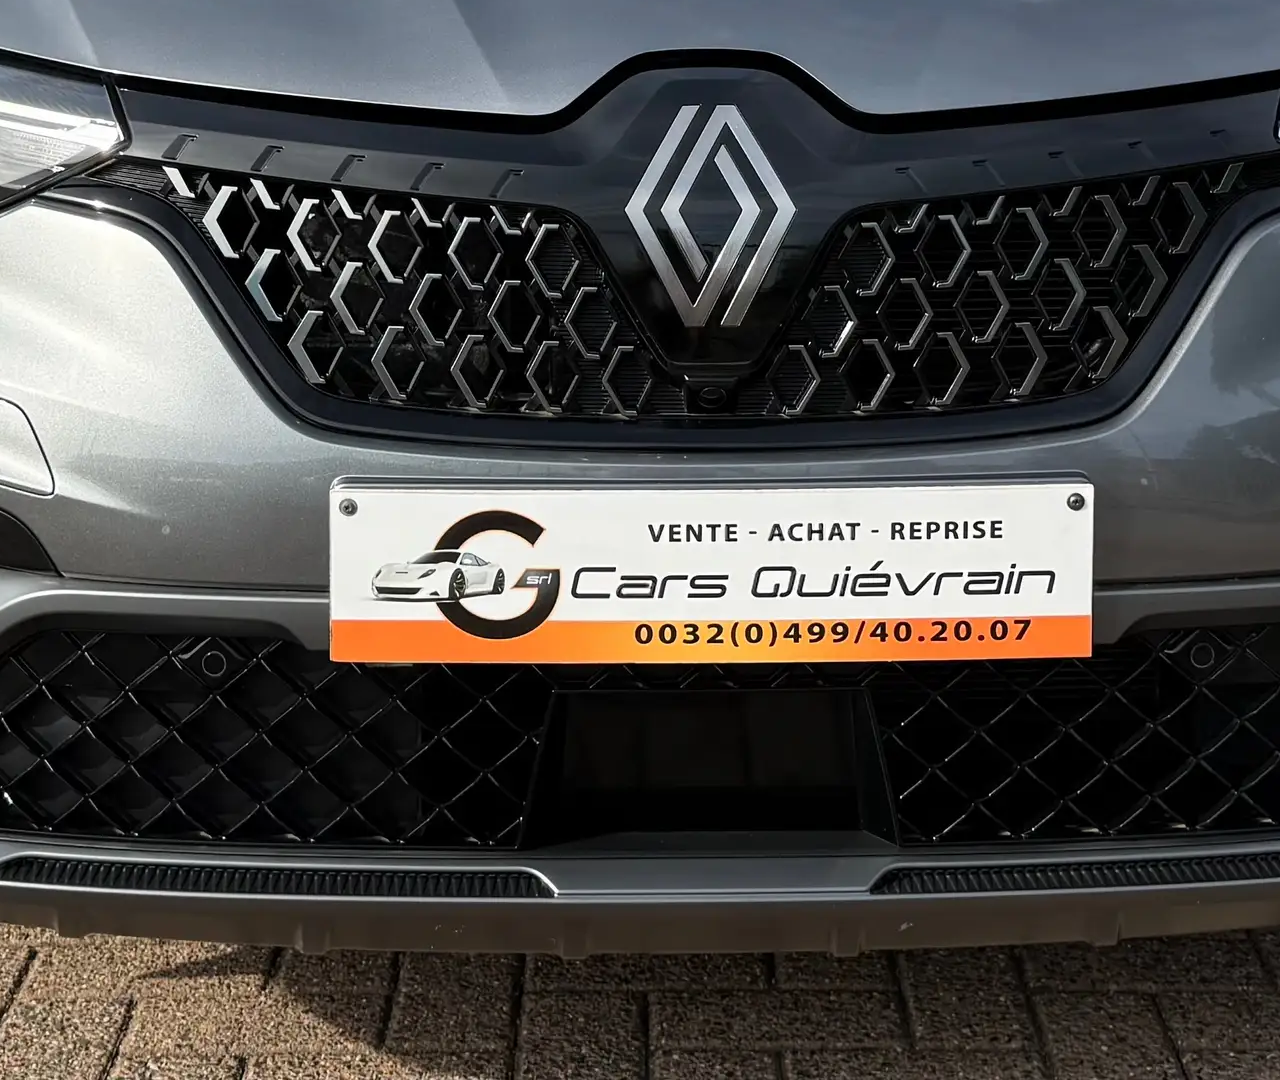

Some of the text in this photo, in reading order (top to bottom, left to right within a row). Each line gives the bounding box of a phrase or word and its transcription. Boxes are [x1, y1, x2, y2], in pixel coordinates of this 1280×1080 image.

[647, 522, 738, 543] VENTE
[767, 521, 861, 542] ACHAT
[890, 519, 1004, 541] REPRISE
[525, 571, 553, 585] srl
[570, 559, 1056, 599] Cars Quiévrain
[634, 619, 1033, 648] 0032(0)499/40.20.07
